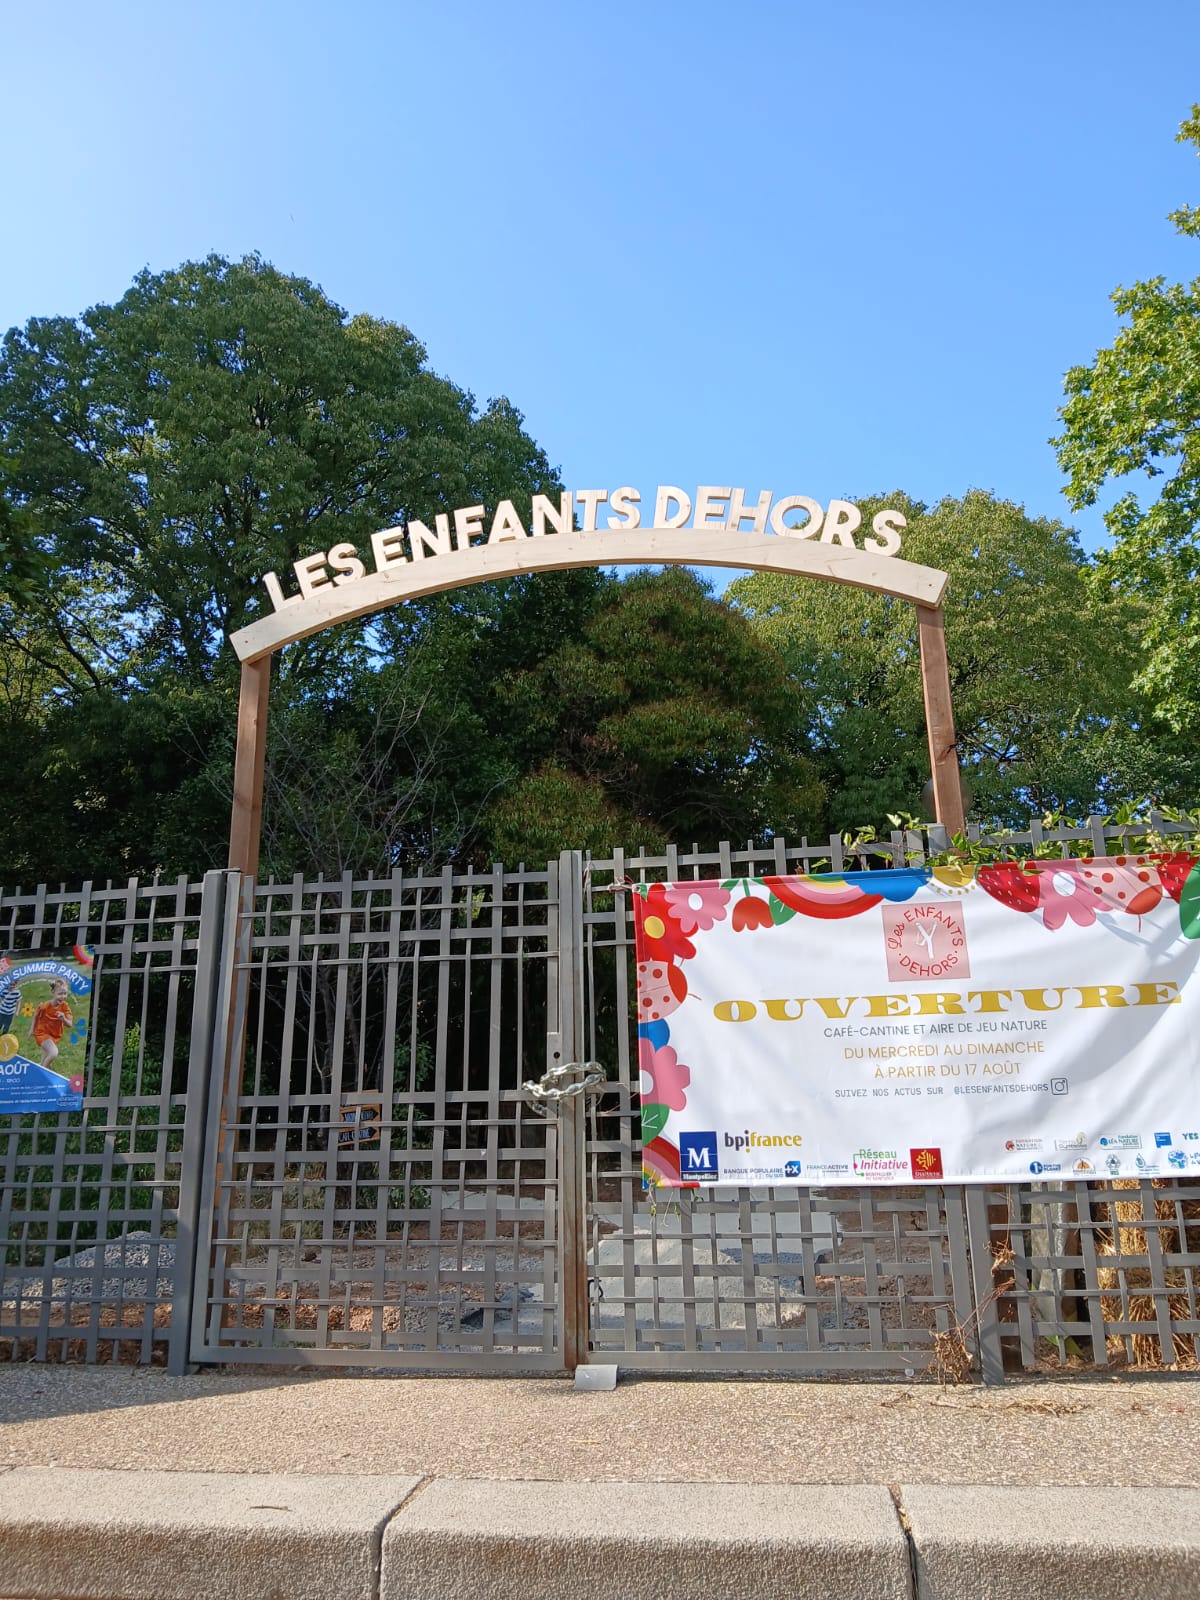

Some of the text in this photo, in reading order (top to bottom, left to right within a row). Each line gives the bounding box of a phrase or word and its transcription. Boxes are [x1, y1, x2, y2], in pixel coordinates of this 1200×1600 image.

[262, 485, 908, 611] LES ENFANTS DEHORS
[887, 906, 964, 949] Les ENFANTS
[900, 953, 959, 977] DEHORS
[12, 963, 57, 980] SUMMER
[57, 965, 89, 990] PARTY
[712, 981, 1183, 1023] OUVERTURE
[823, 1020, 1048, 1038] CAFÉ-CANTINE ET AIRE DE JEU NATURE
[844, 1041, 1045, 1059] DU MERCREDI AU DIMANCHE
[874, 1060, 1021, 1079] À PARTIR DU 17 AOÛT
[835, 1083, 1049, 1098] SUIVEZ NOS ACTUS SUR @LESENFANTSDEHORS
[724, 1130, 803, 1153] bpifrance
[1182, 1132, 1199, 1140] YES
[860, 1148, 897, 1159] Réseau
[860, 1159, 908, 1170] Initiative
